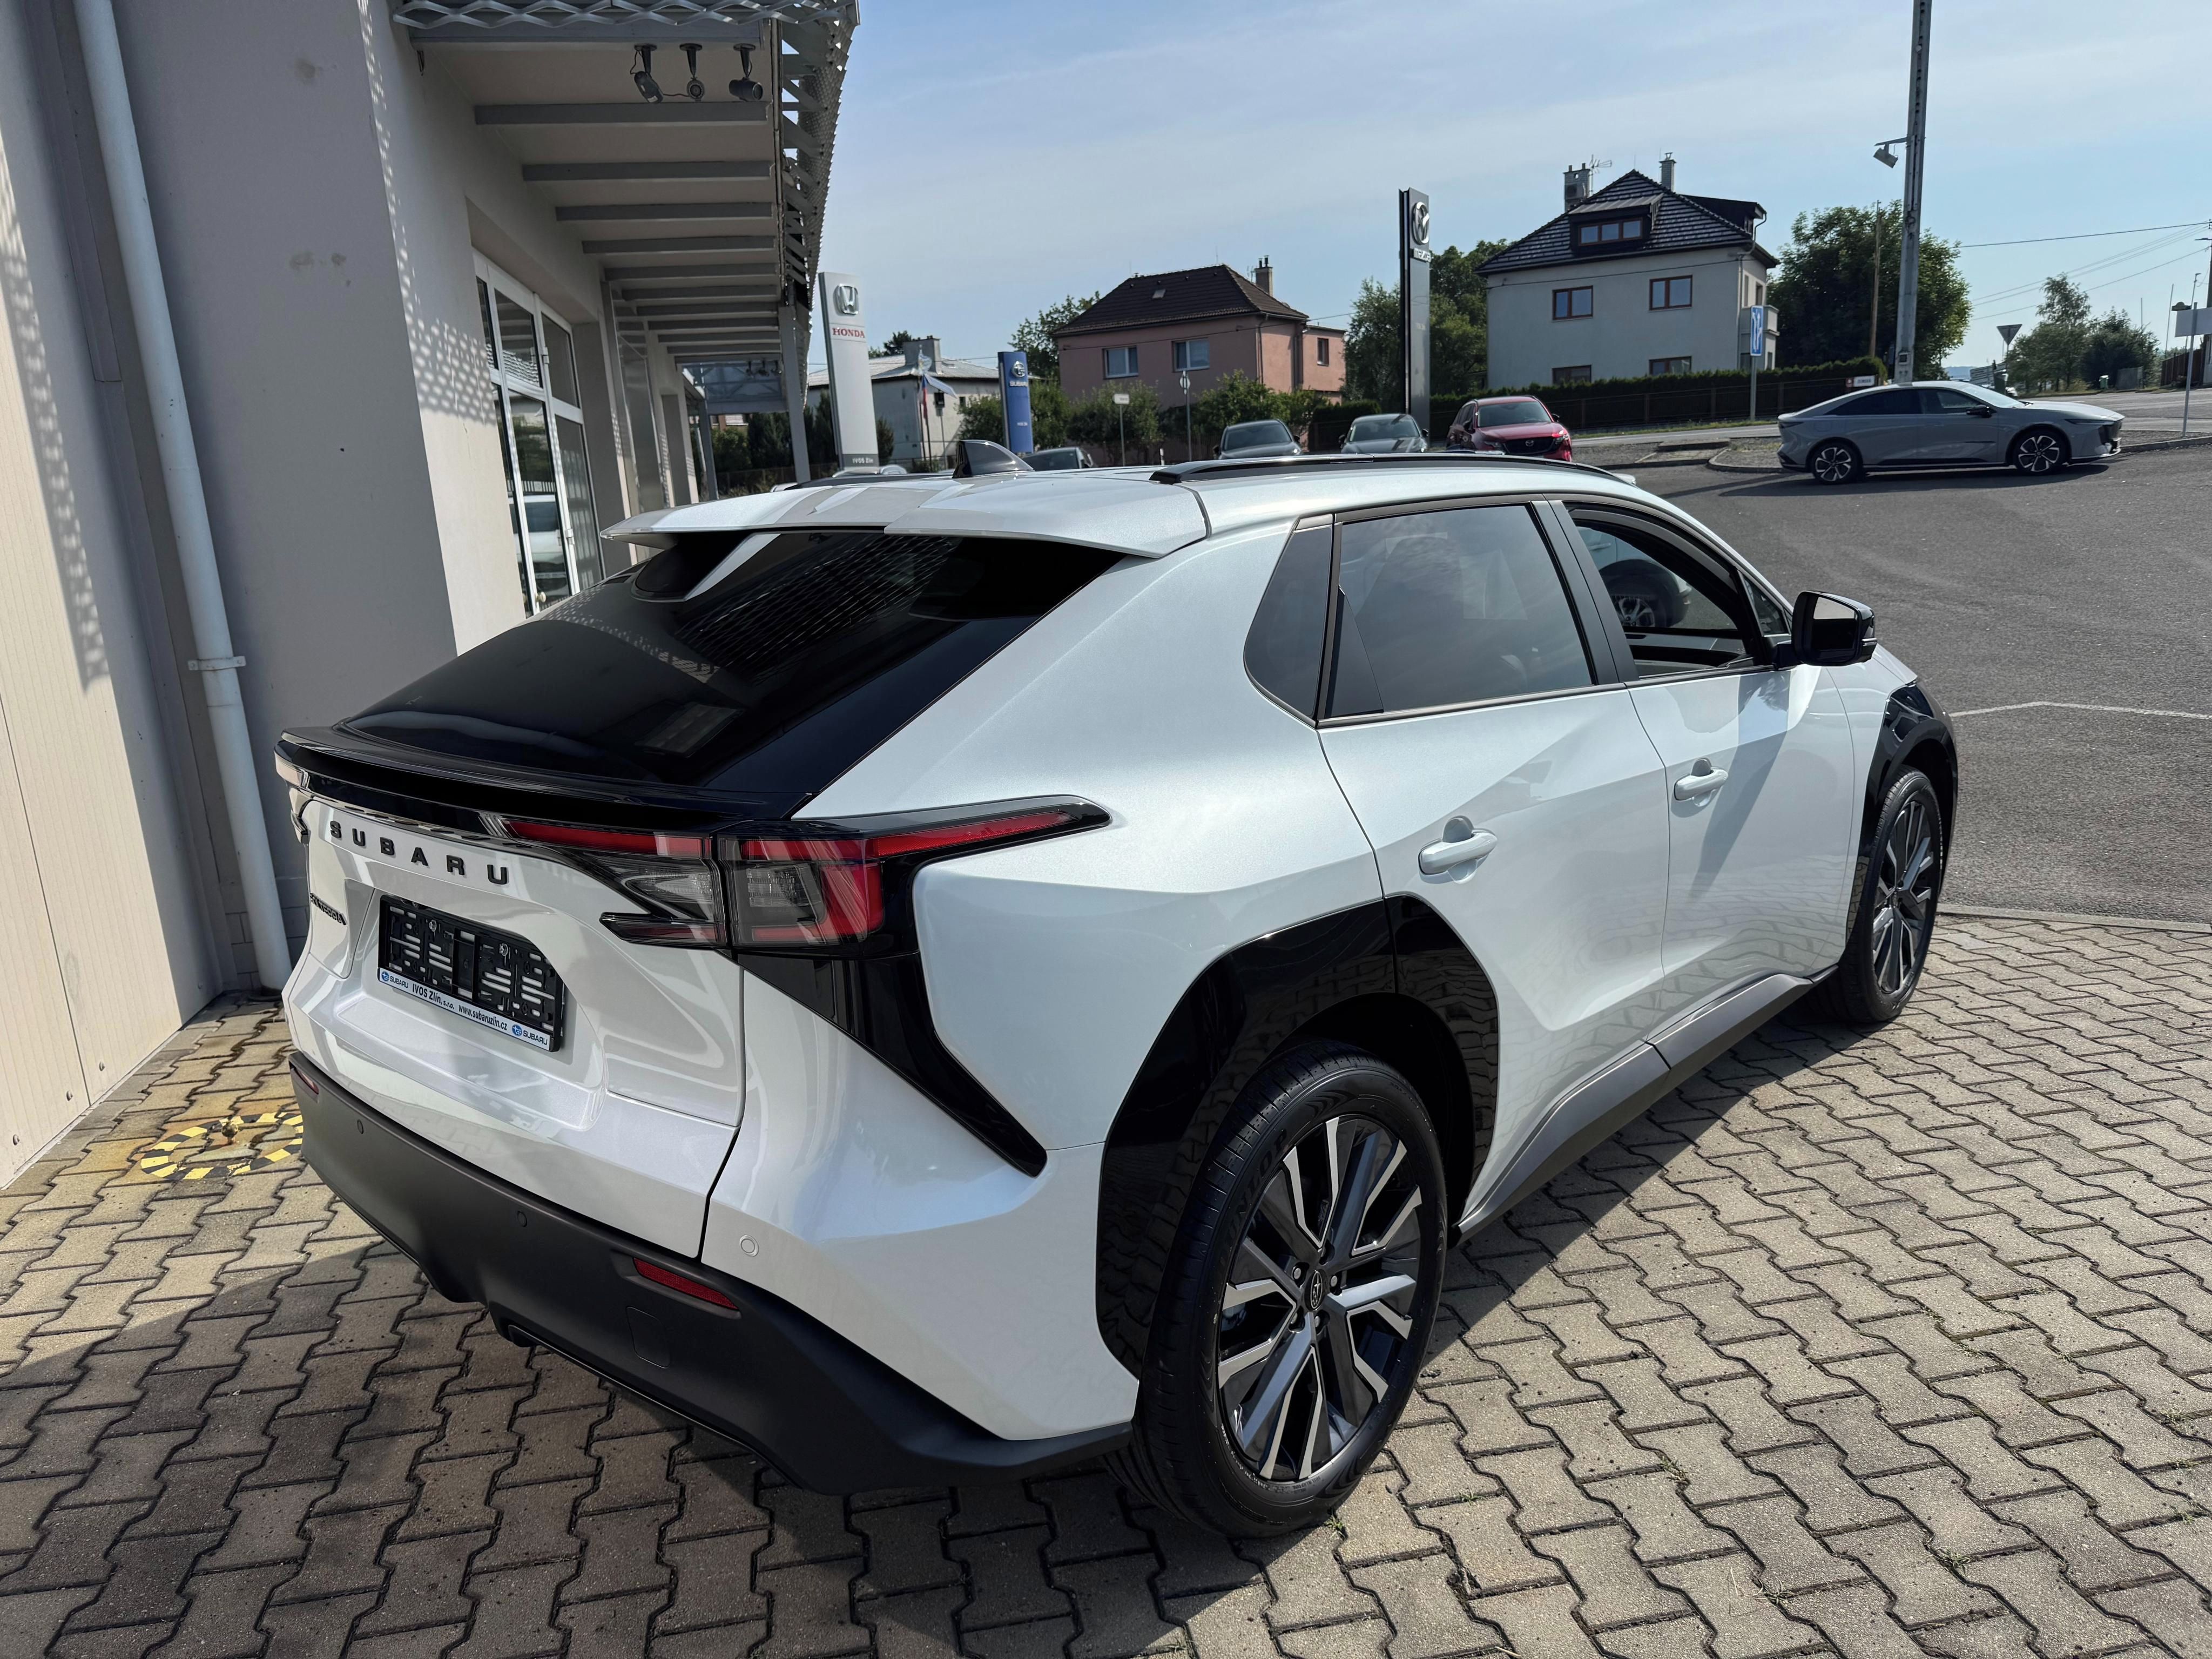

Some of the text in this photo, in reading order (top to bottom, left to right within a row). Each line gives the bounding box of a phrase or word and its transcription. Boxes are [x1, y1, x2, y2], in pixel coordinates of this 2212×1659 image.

[832, 328, 865, 339] HONDA
[330, 820, 507, 885] SUBARU
[389, 975, 409, 989] SUBARU
[412, 983, 508, 1031] IVOS Zlín, s.r.o. www.subaruzlin.cz
[522, 1030, 548, 1046] SUBARU
